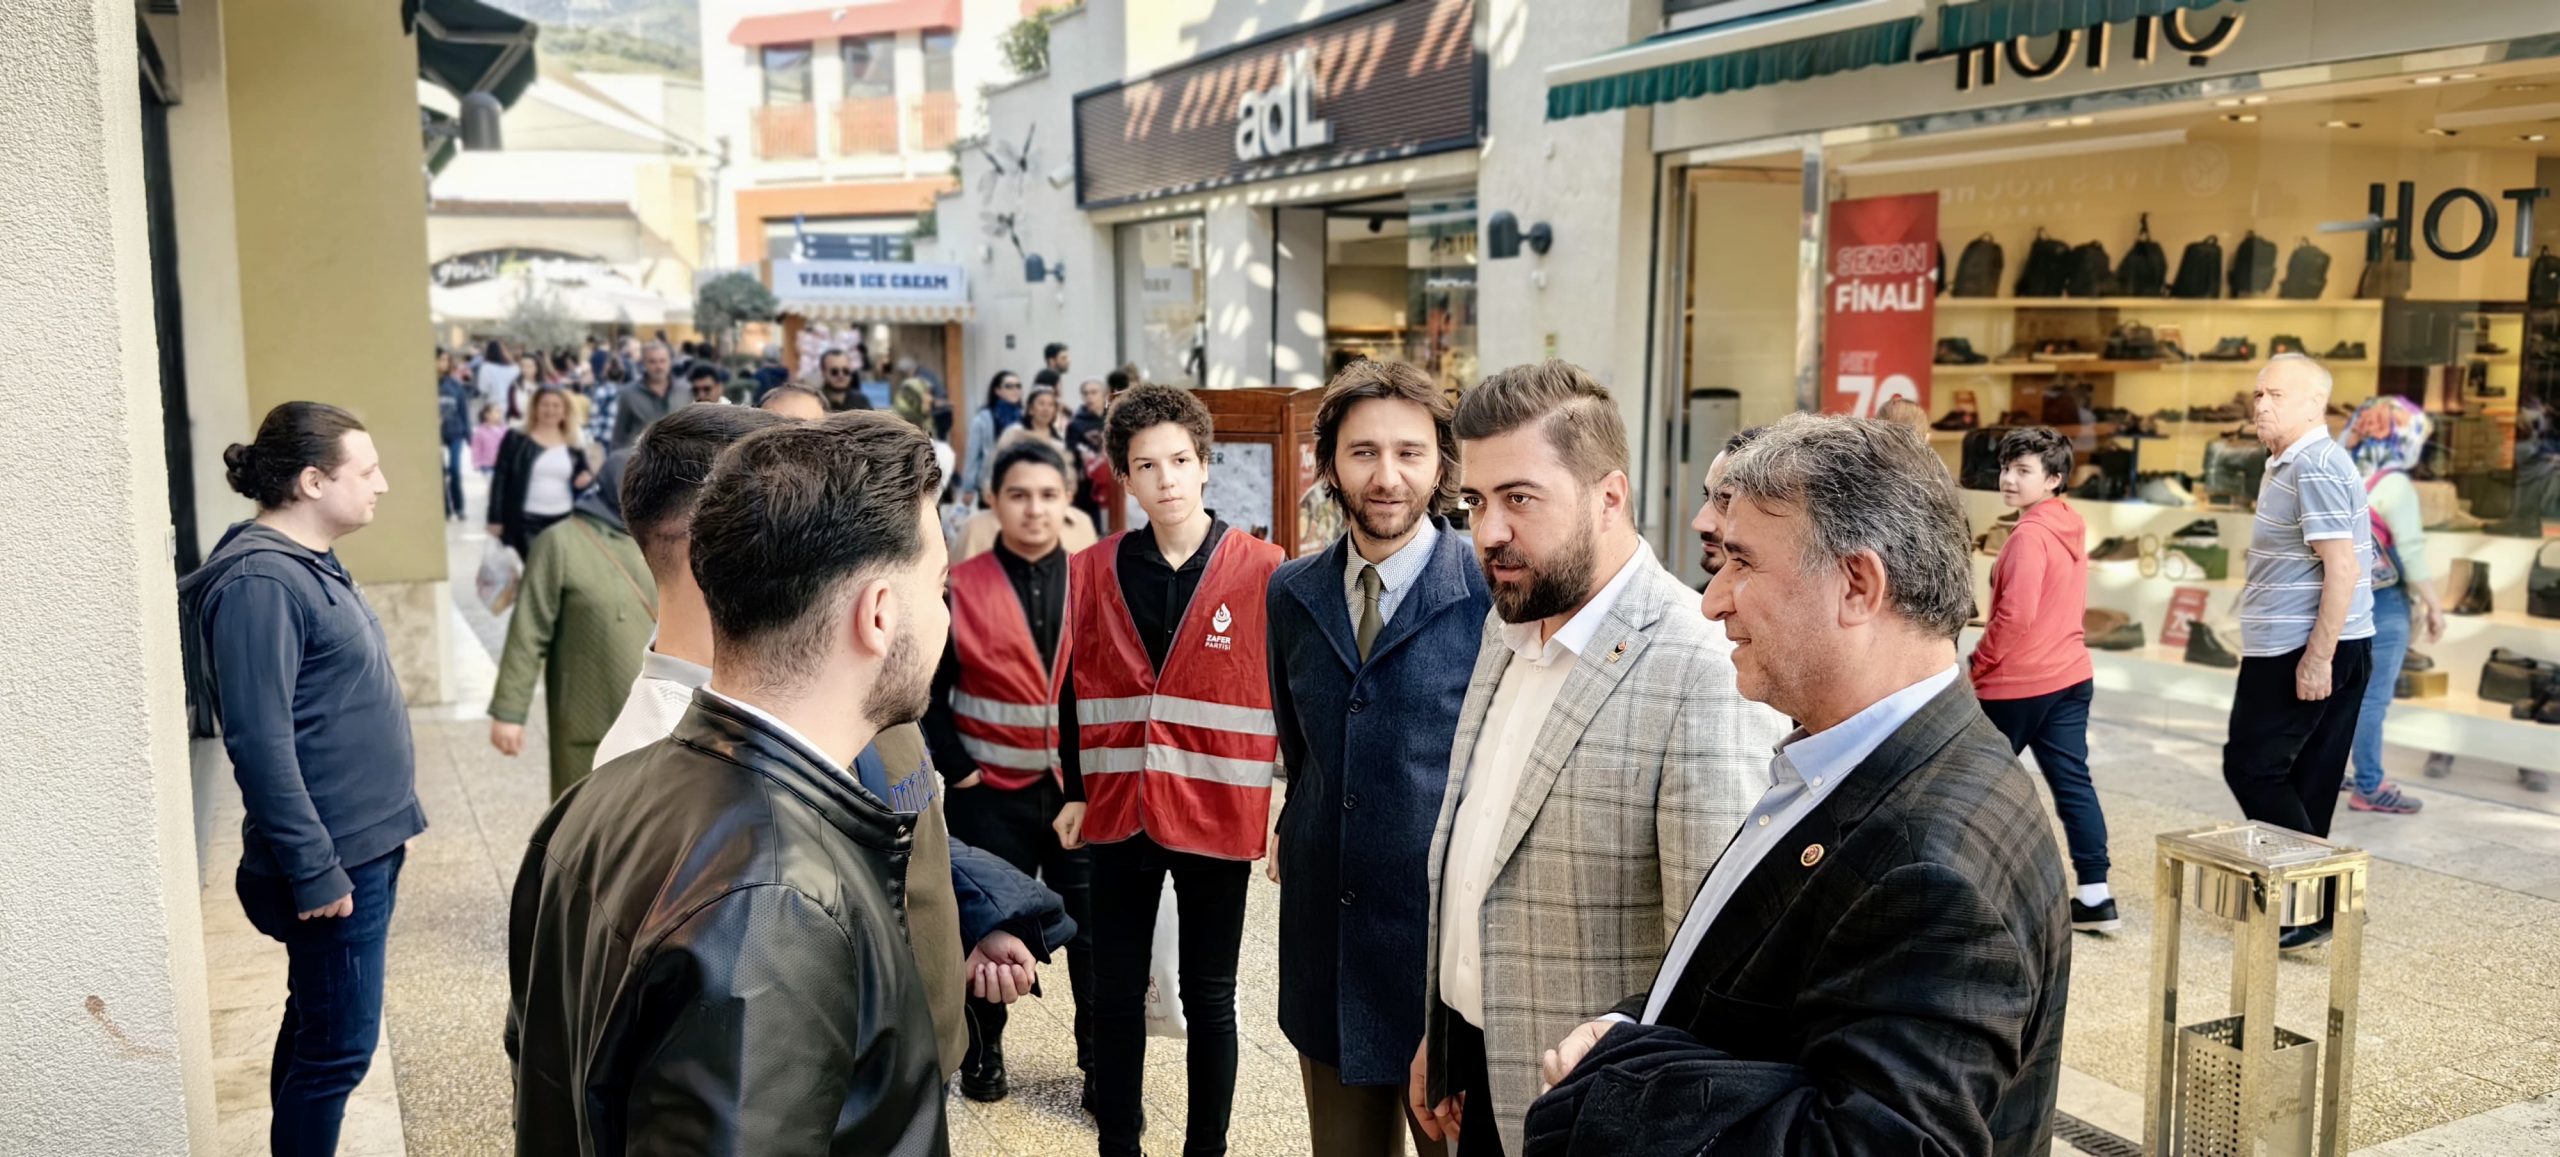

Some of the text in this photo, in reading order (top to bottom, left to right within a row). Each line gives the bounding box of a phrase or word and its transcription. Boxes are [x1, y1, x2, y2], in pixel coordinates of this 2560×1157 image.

[2318, 181, 2550, 262] HOT
[1837, 243, 1927, 276] SEZON
[799, 272, 948, 289] VAGON ICE CREAM
[1835, 275, 1926, 313] FİNALİ
[1839, 352, 1878, 375] NET
[1206, 634, 1231, 644] ZAFER
